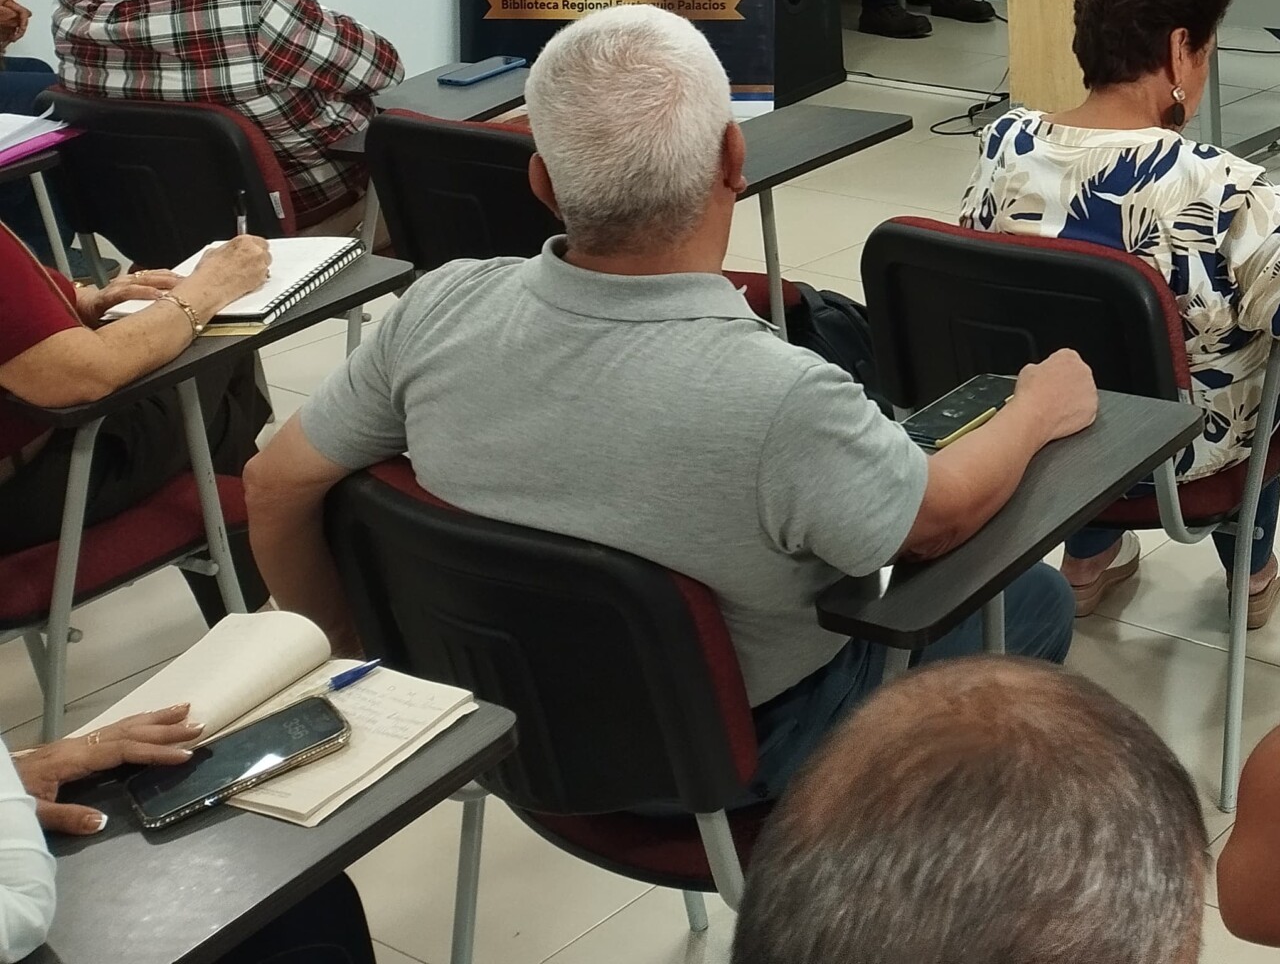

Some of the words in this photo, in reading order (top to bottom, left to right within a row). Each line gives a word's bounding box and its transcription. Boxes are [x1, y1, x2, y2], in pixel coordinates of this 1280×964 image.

[501, 0, 559, 10] Biblioteca
[562, 0, 612, 12] Regional
[677, 0, 727, 10] Palacios
